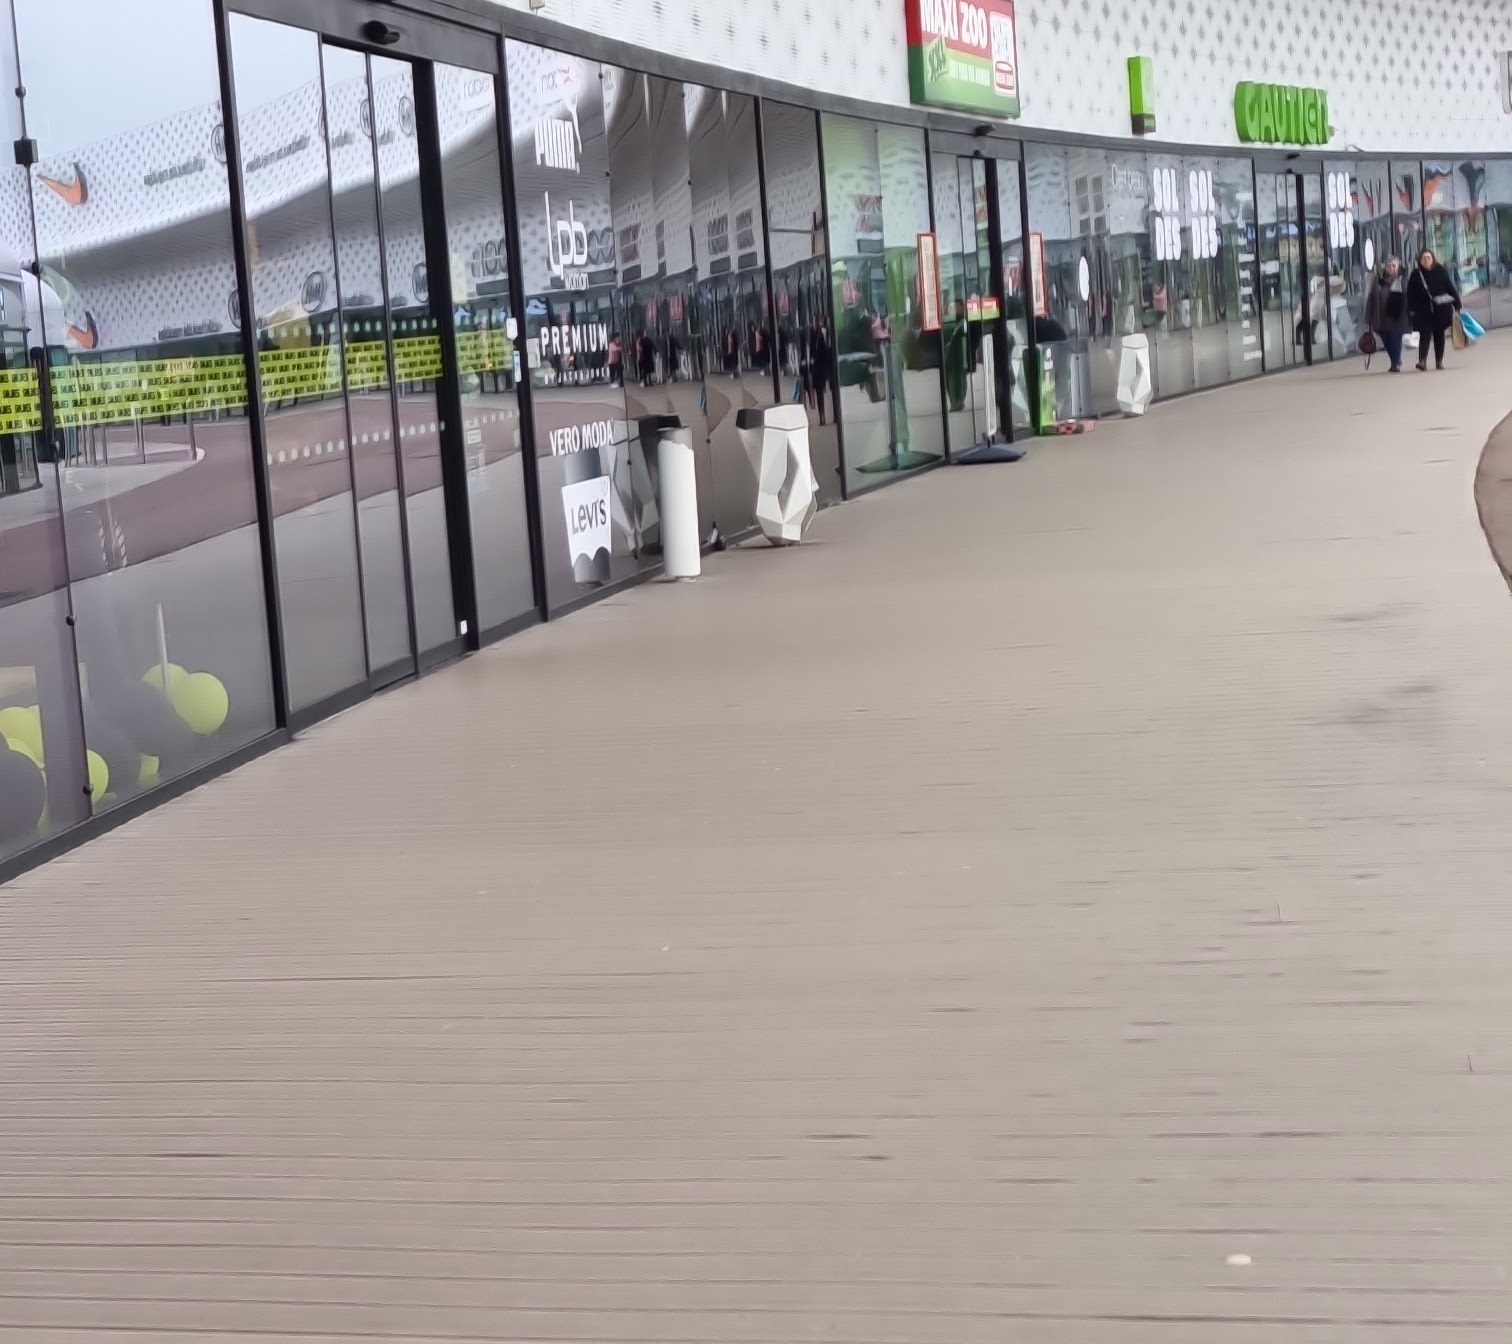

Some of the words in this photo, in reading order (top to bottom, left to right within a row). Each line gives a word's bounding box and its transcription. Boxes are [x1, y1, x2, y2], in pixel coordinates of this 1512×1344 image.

[960, 1, 988, 49] ZOO
[540, 323, 609, 356] PREMIUM
[549, 424, 580, 456] VERO
[582, 419, 614, 450] MODA
